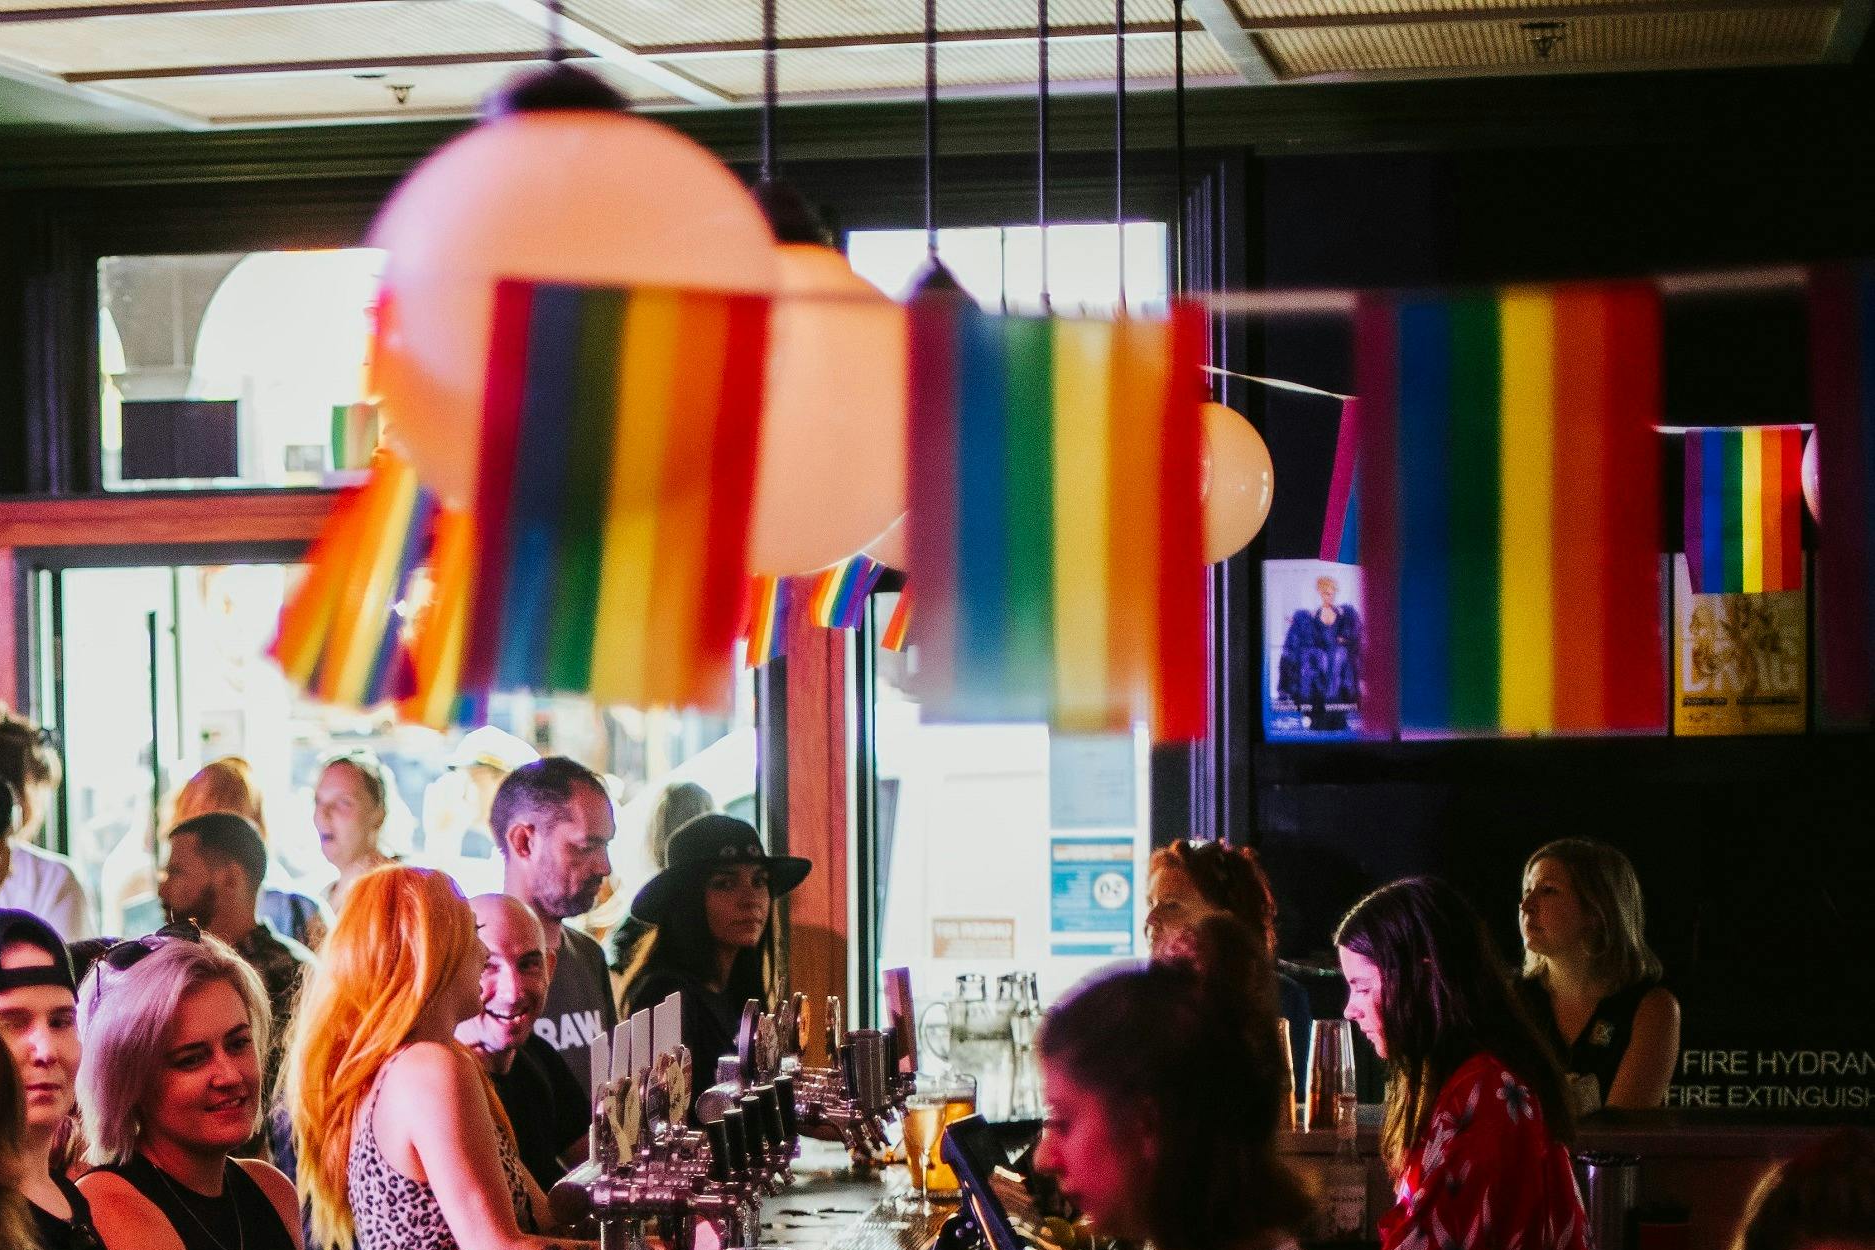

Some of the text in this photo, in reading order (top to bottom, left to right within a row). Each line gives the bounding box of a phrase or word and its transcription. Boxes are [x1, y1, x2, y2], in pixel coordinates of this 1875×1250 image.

[533, 1010, 602, 1051] RAW
[1683, 1050, 1750, 1075] FIRE
[1664, 1085, 1722, 1107] FIRE
